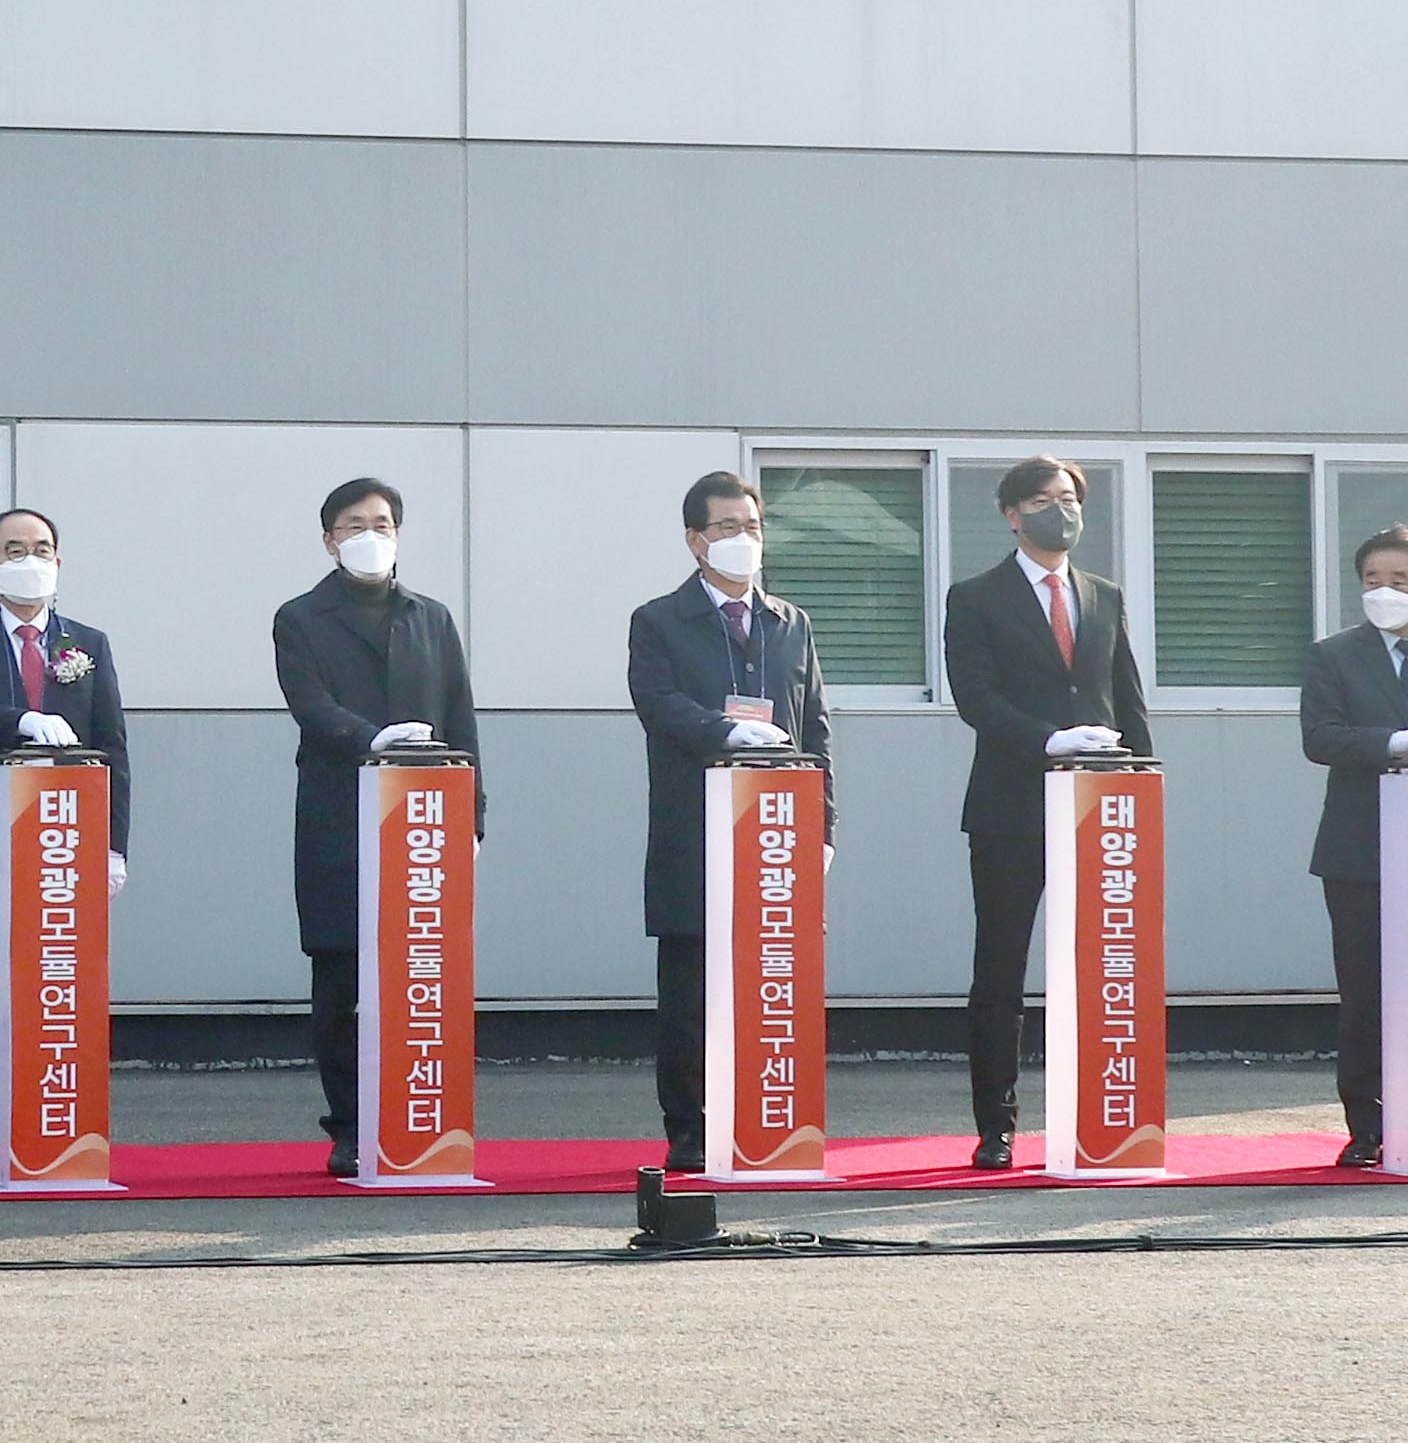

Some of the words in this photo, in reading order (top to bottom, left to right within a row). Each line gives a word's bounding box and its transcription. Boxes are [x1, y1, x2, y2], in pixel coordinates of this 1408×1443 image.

[39, 789, 80, 1138] 태양광모듈연구센터
[406, 790, 446, 1134] 태양광모듈연구센터
[758, 792, 797, 1131] 태양광모듈연구센터
[1100, 795, 1137, 1128] 태양광모듈연구센터
